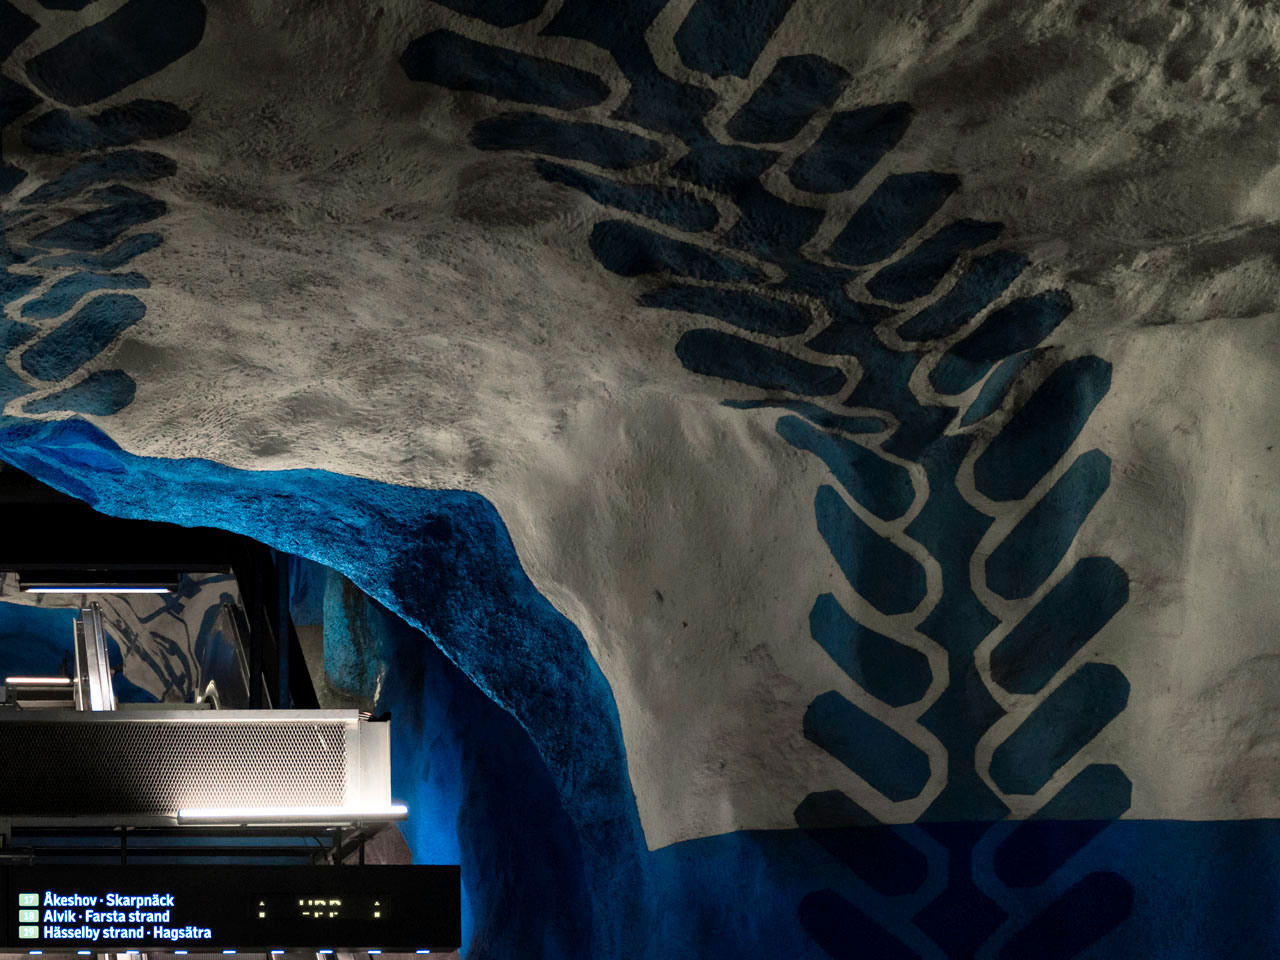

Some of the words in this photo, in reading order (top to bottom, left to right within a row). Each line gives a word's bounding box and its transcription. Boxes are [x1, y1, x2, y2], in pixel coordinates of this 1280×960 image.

[24, 895, 34, 905] 17
[43, 891, 97, 906] Åkeshov
[106, 892, 174, 908] Skarpnäck
[24, 911, 34, 921] 18
[43, 909, 76, 923] Alvik
[85, 909, 126, 923] Farsta
[128, 909, 170, 923] strand
[24, 927, 34, 937] 19
[43, 925, 100, 941] Hässelby
[102, 925, 144, 939] strand
[153, 925, 211, 942] Hagsätra
